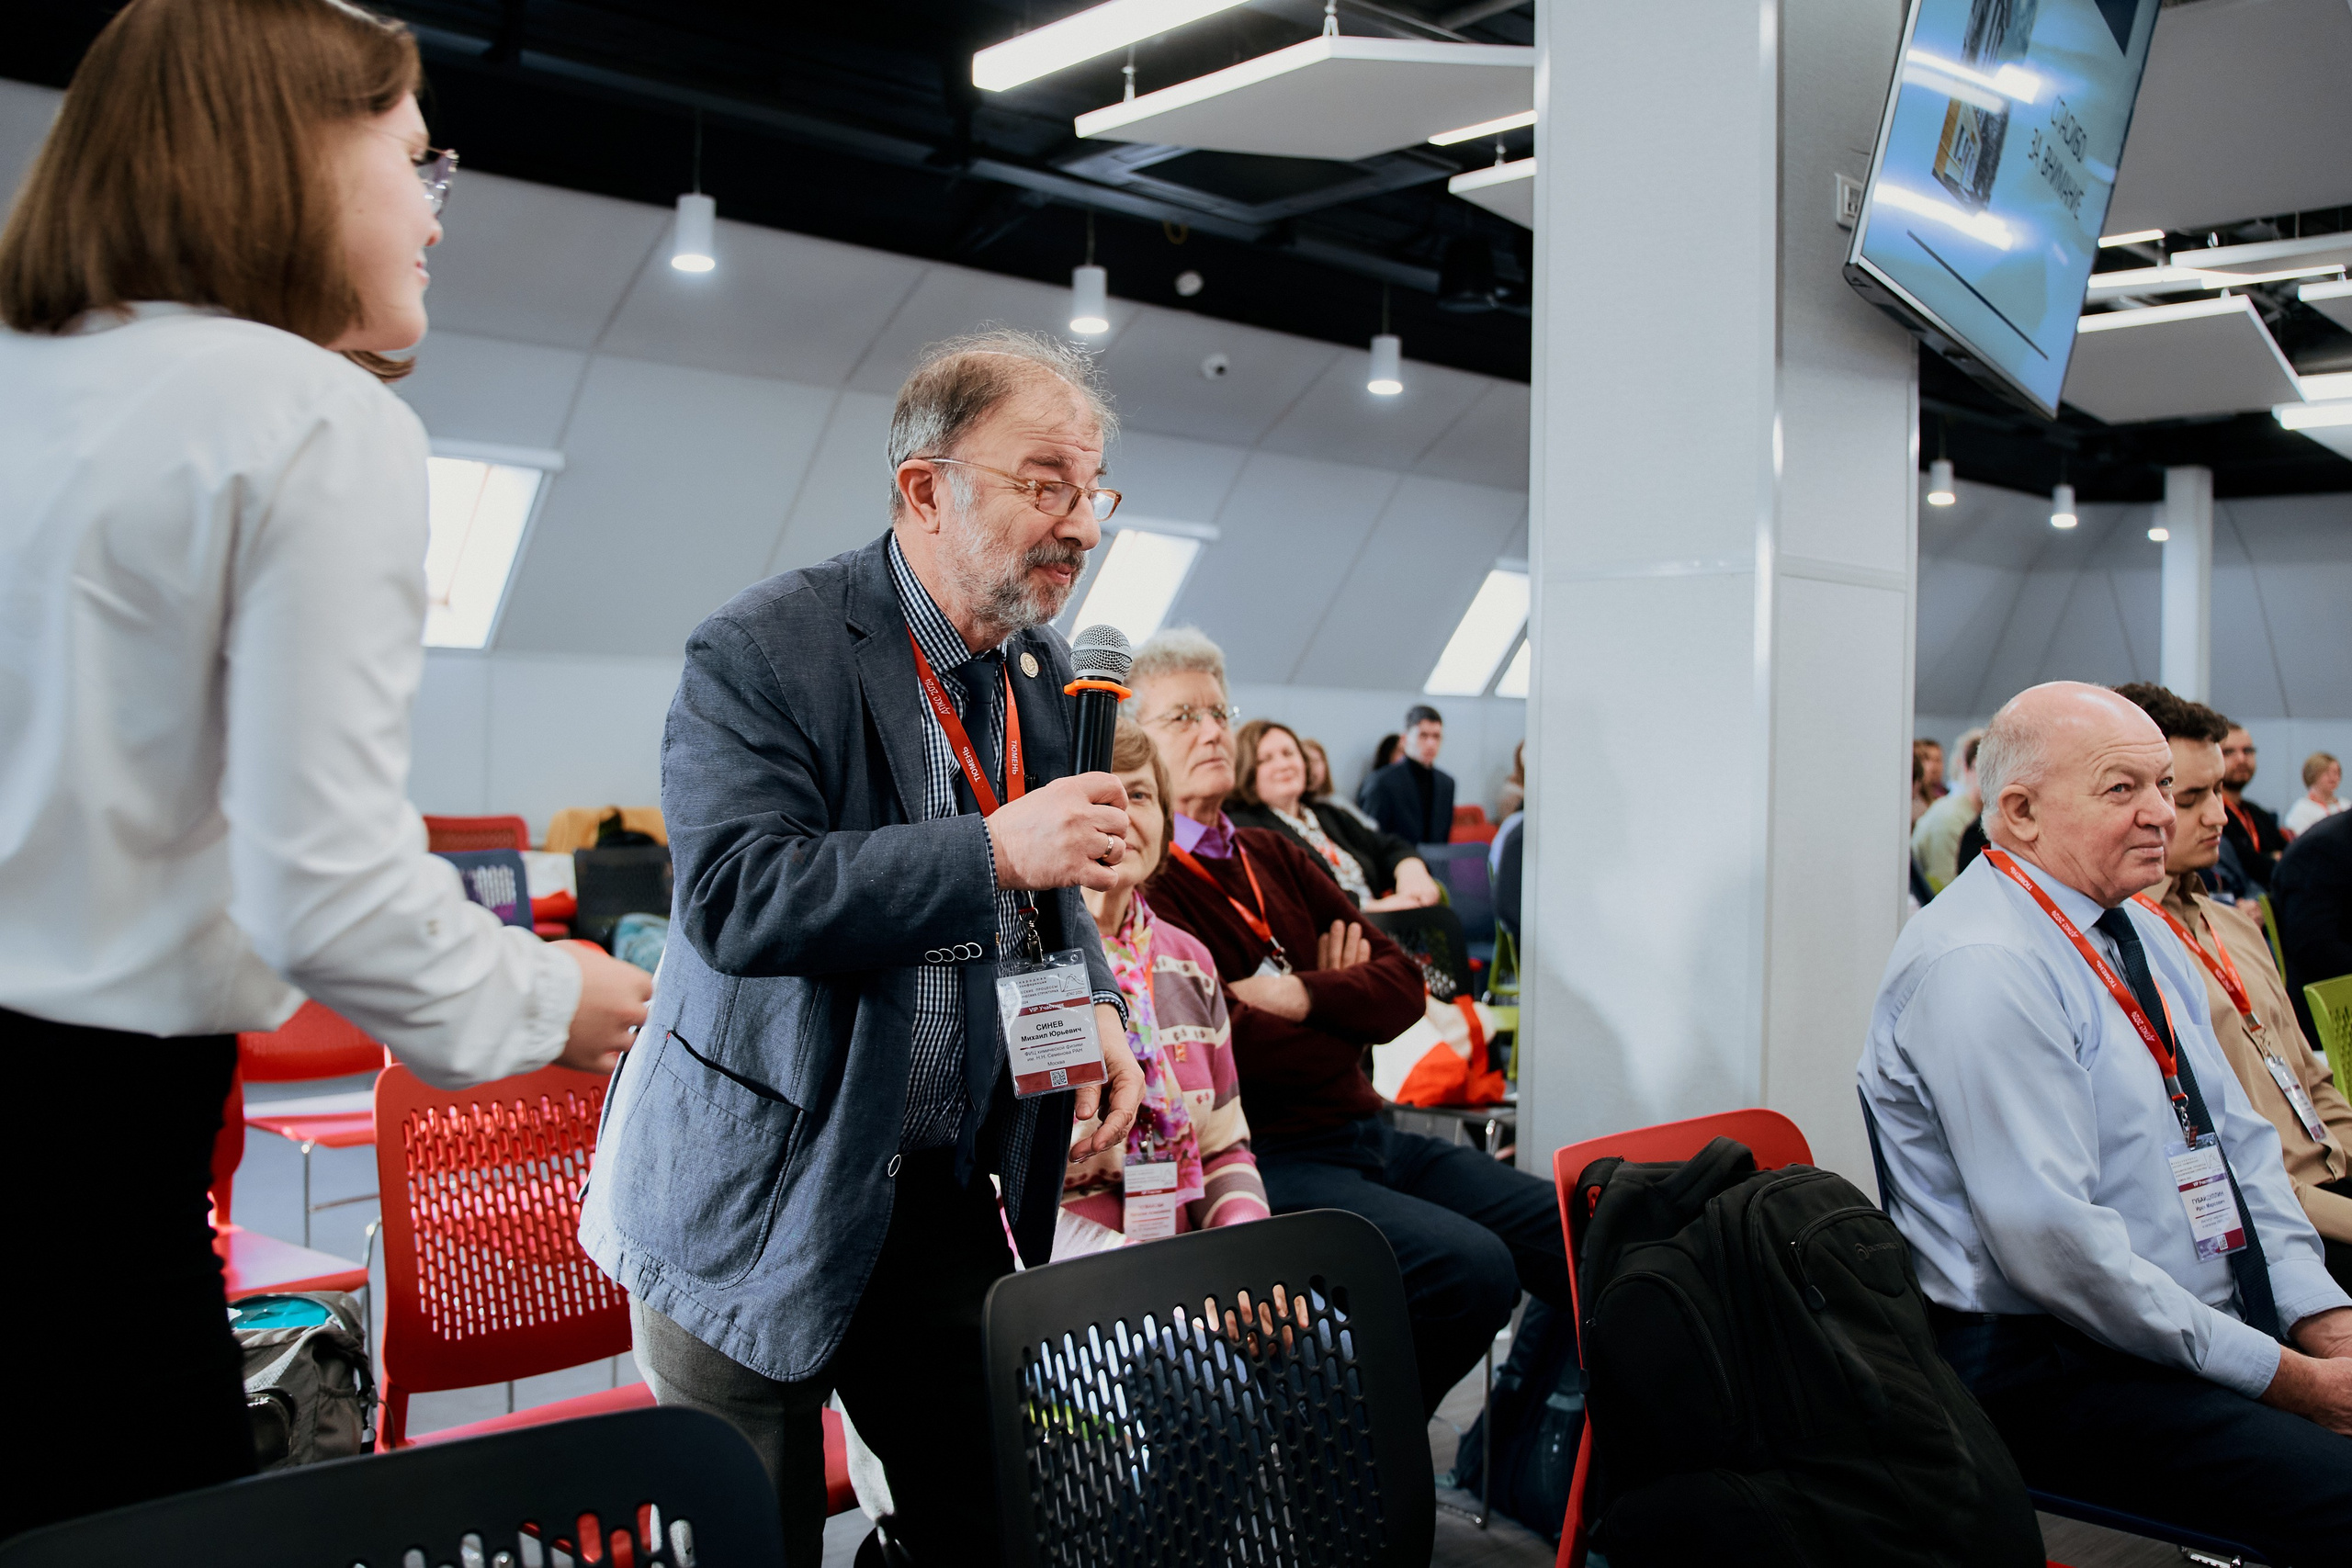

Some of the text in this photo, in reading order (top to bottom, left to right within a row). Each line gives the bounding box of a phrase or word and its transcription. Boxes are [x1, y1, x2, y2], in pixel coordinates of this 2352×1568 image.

[924, 678, 951, 715] ДПКС 2024
[962, 746, 981, 783] ТЮМЕНЬ
[1011, 739, 1019, 775] ТЮМЕНЬ
[2009, 865, 2033, 891] ТЮМЕНЬ
[2096, 959, 2118, 989] ТЮМЕНЬ
[1021, 1027, 1082, 1043] Михаил Юрьевич
[1035, 1020, 1064, 1031] СИНЕВ
